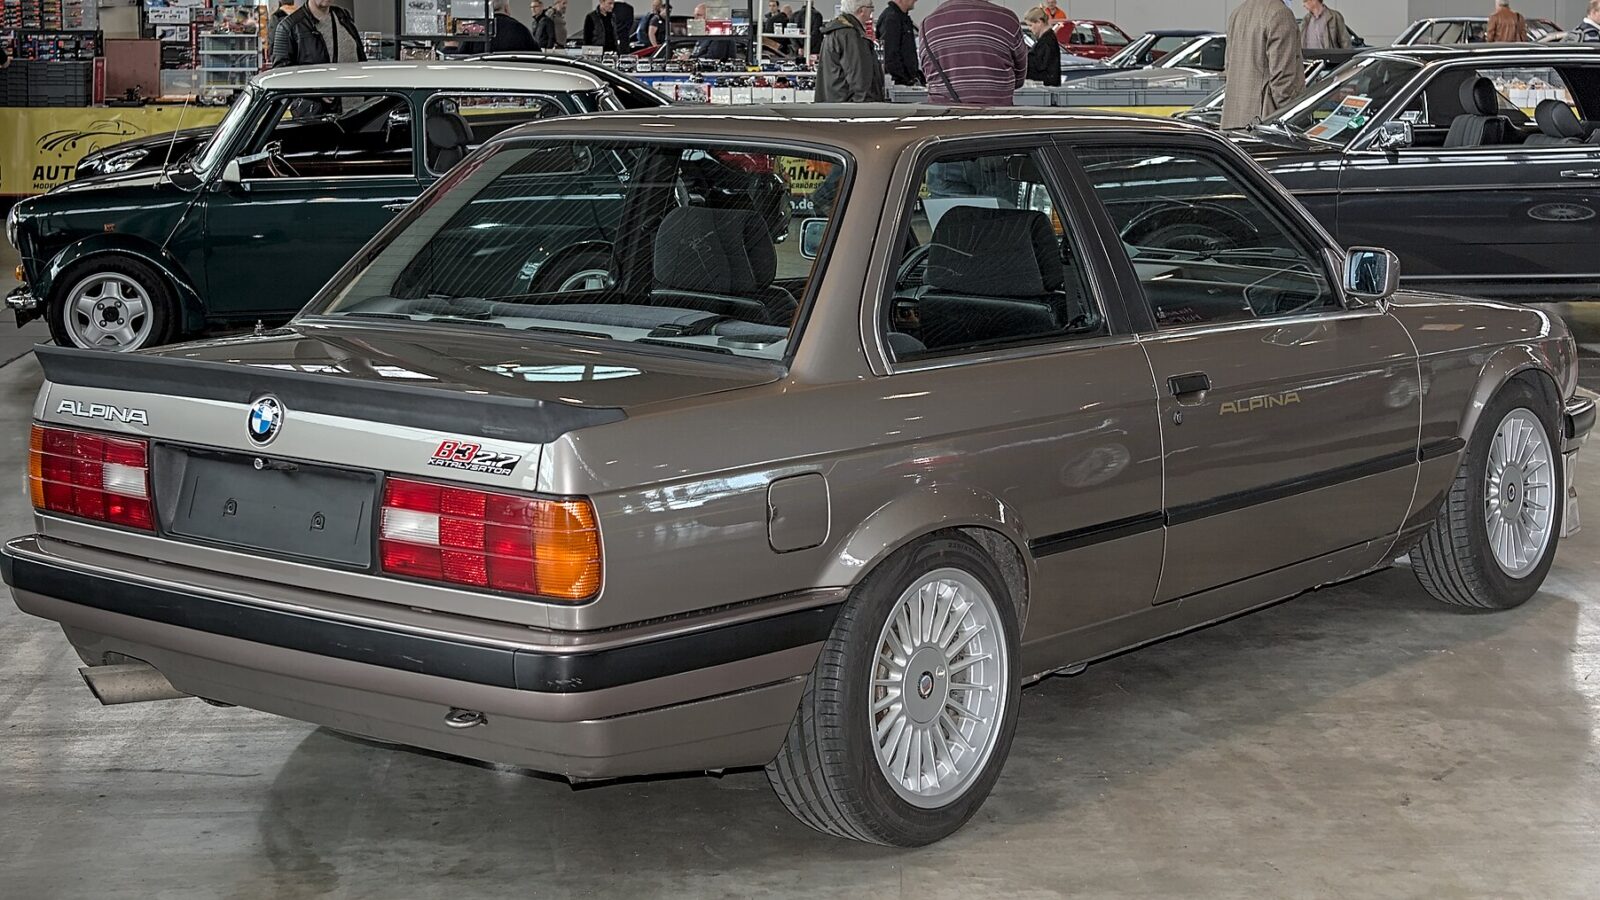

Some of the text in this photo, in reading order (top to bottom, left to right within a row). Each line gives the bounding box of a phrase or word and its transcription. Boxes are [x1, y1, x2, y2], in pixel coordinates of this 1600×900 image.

[32, 165, 76, 181] AUT
[56, 399, 148, 426] ALPINA
[1219, 392, 1300, 415] ALPINA
[432, 440, 481, 463] B3
[427, 457, 512, 476] KATALYSATOR
